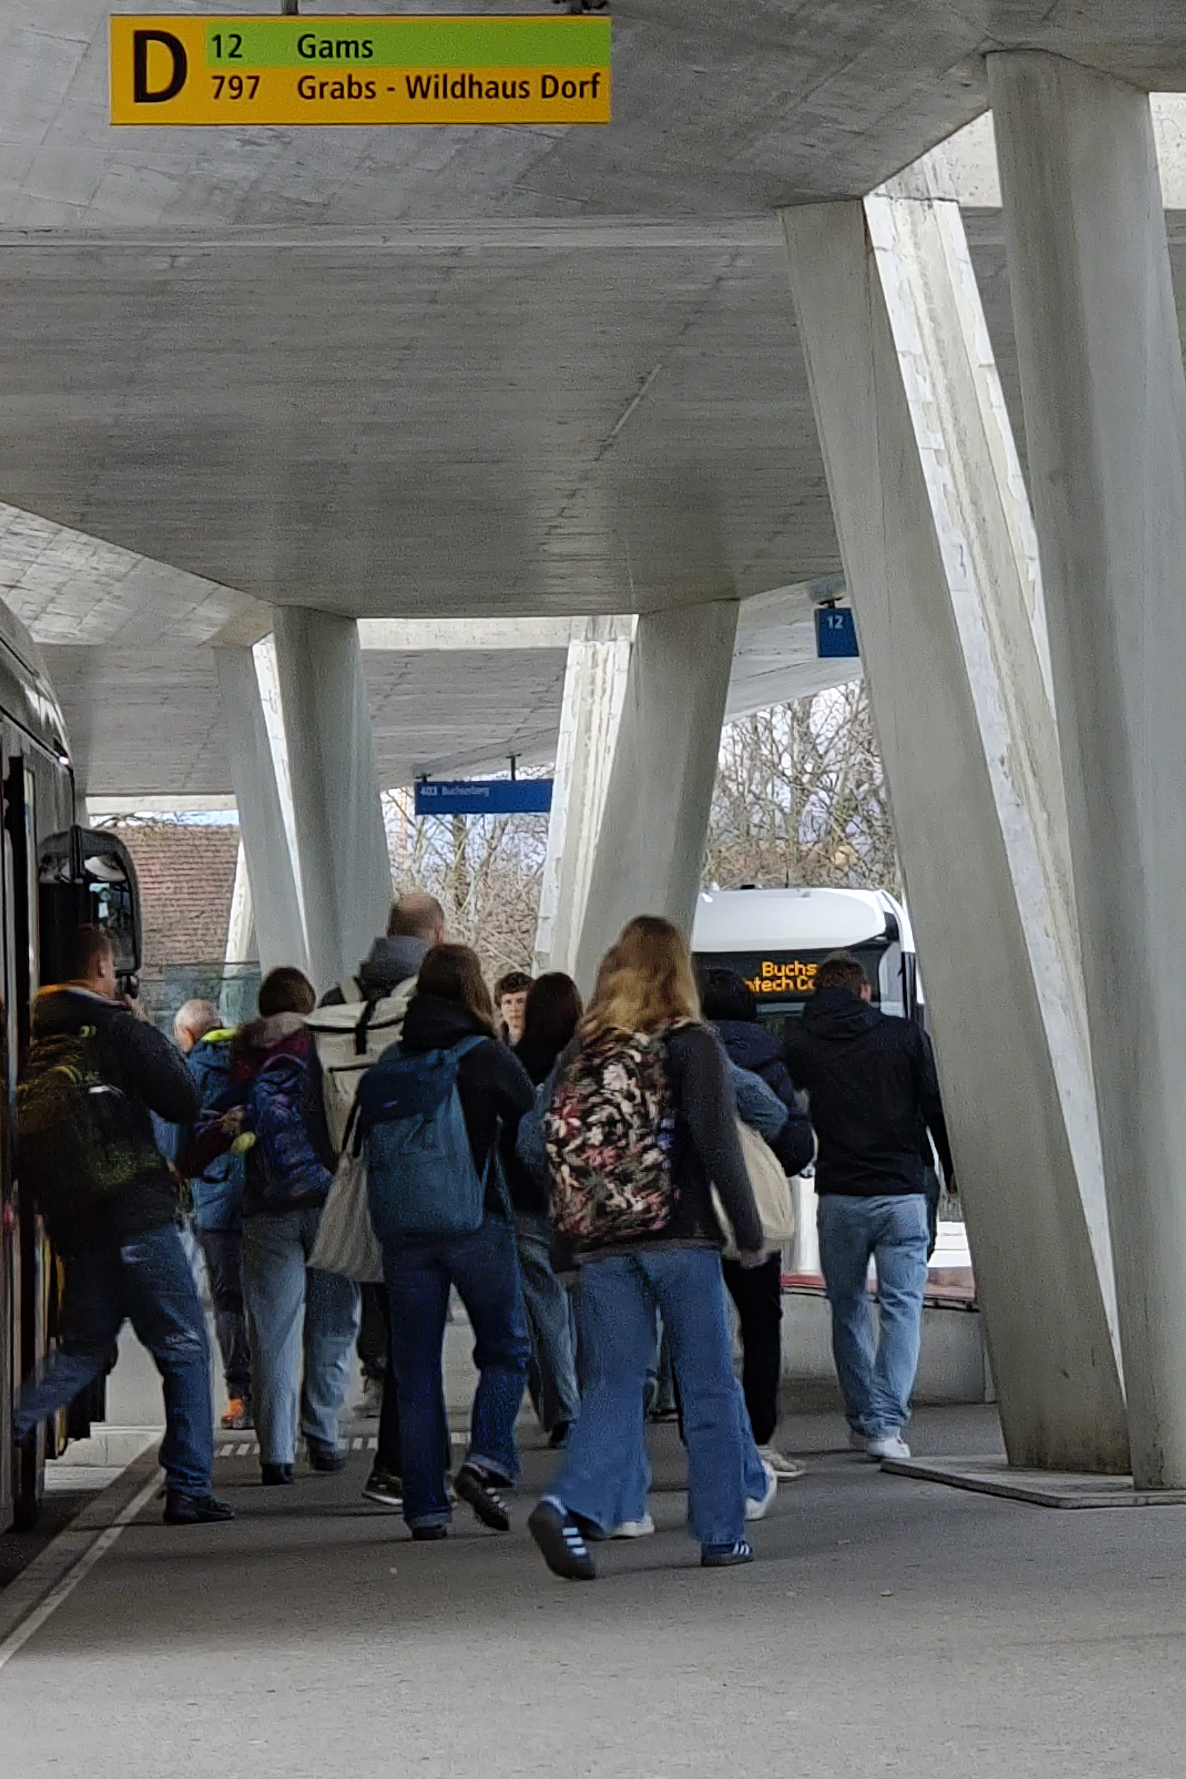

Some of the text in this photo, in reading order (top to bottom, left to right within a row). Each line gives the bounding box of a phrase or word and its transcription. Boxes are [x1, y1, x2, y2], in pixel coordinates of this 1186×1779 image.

[211, 33, 374, 59] 12 Gams
[133, 30, 188, 104] D
[210, 74, 261, 101] 797
[297, 72, 377, 101] Grabs
[404, 72, 531, 100] Wildhaus
[540, 71, 602, 100] Dorf
[826, 614, 844, 629] 12
[762, 960, 818, 978] Buchs
